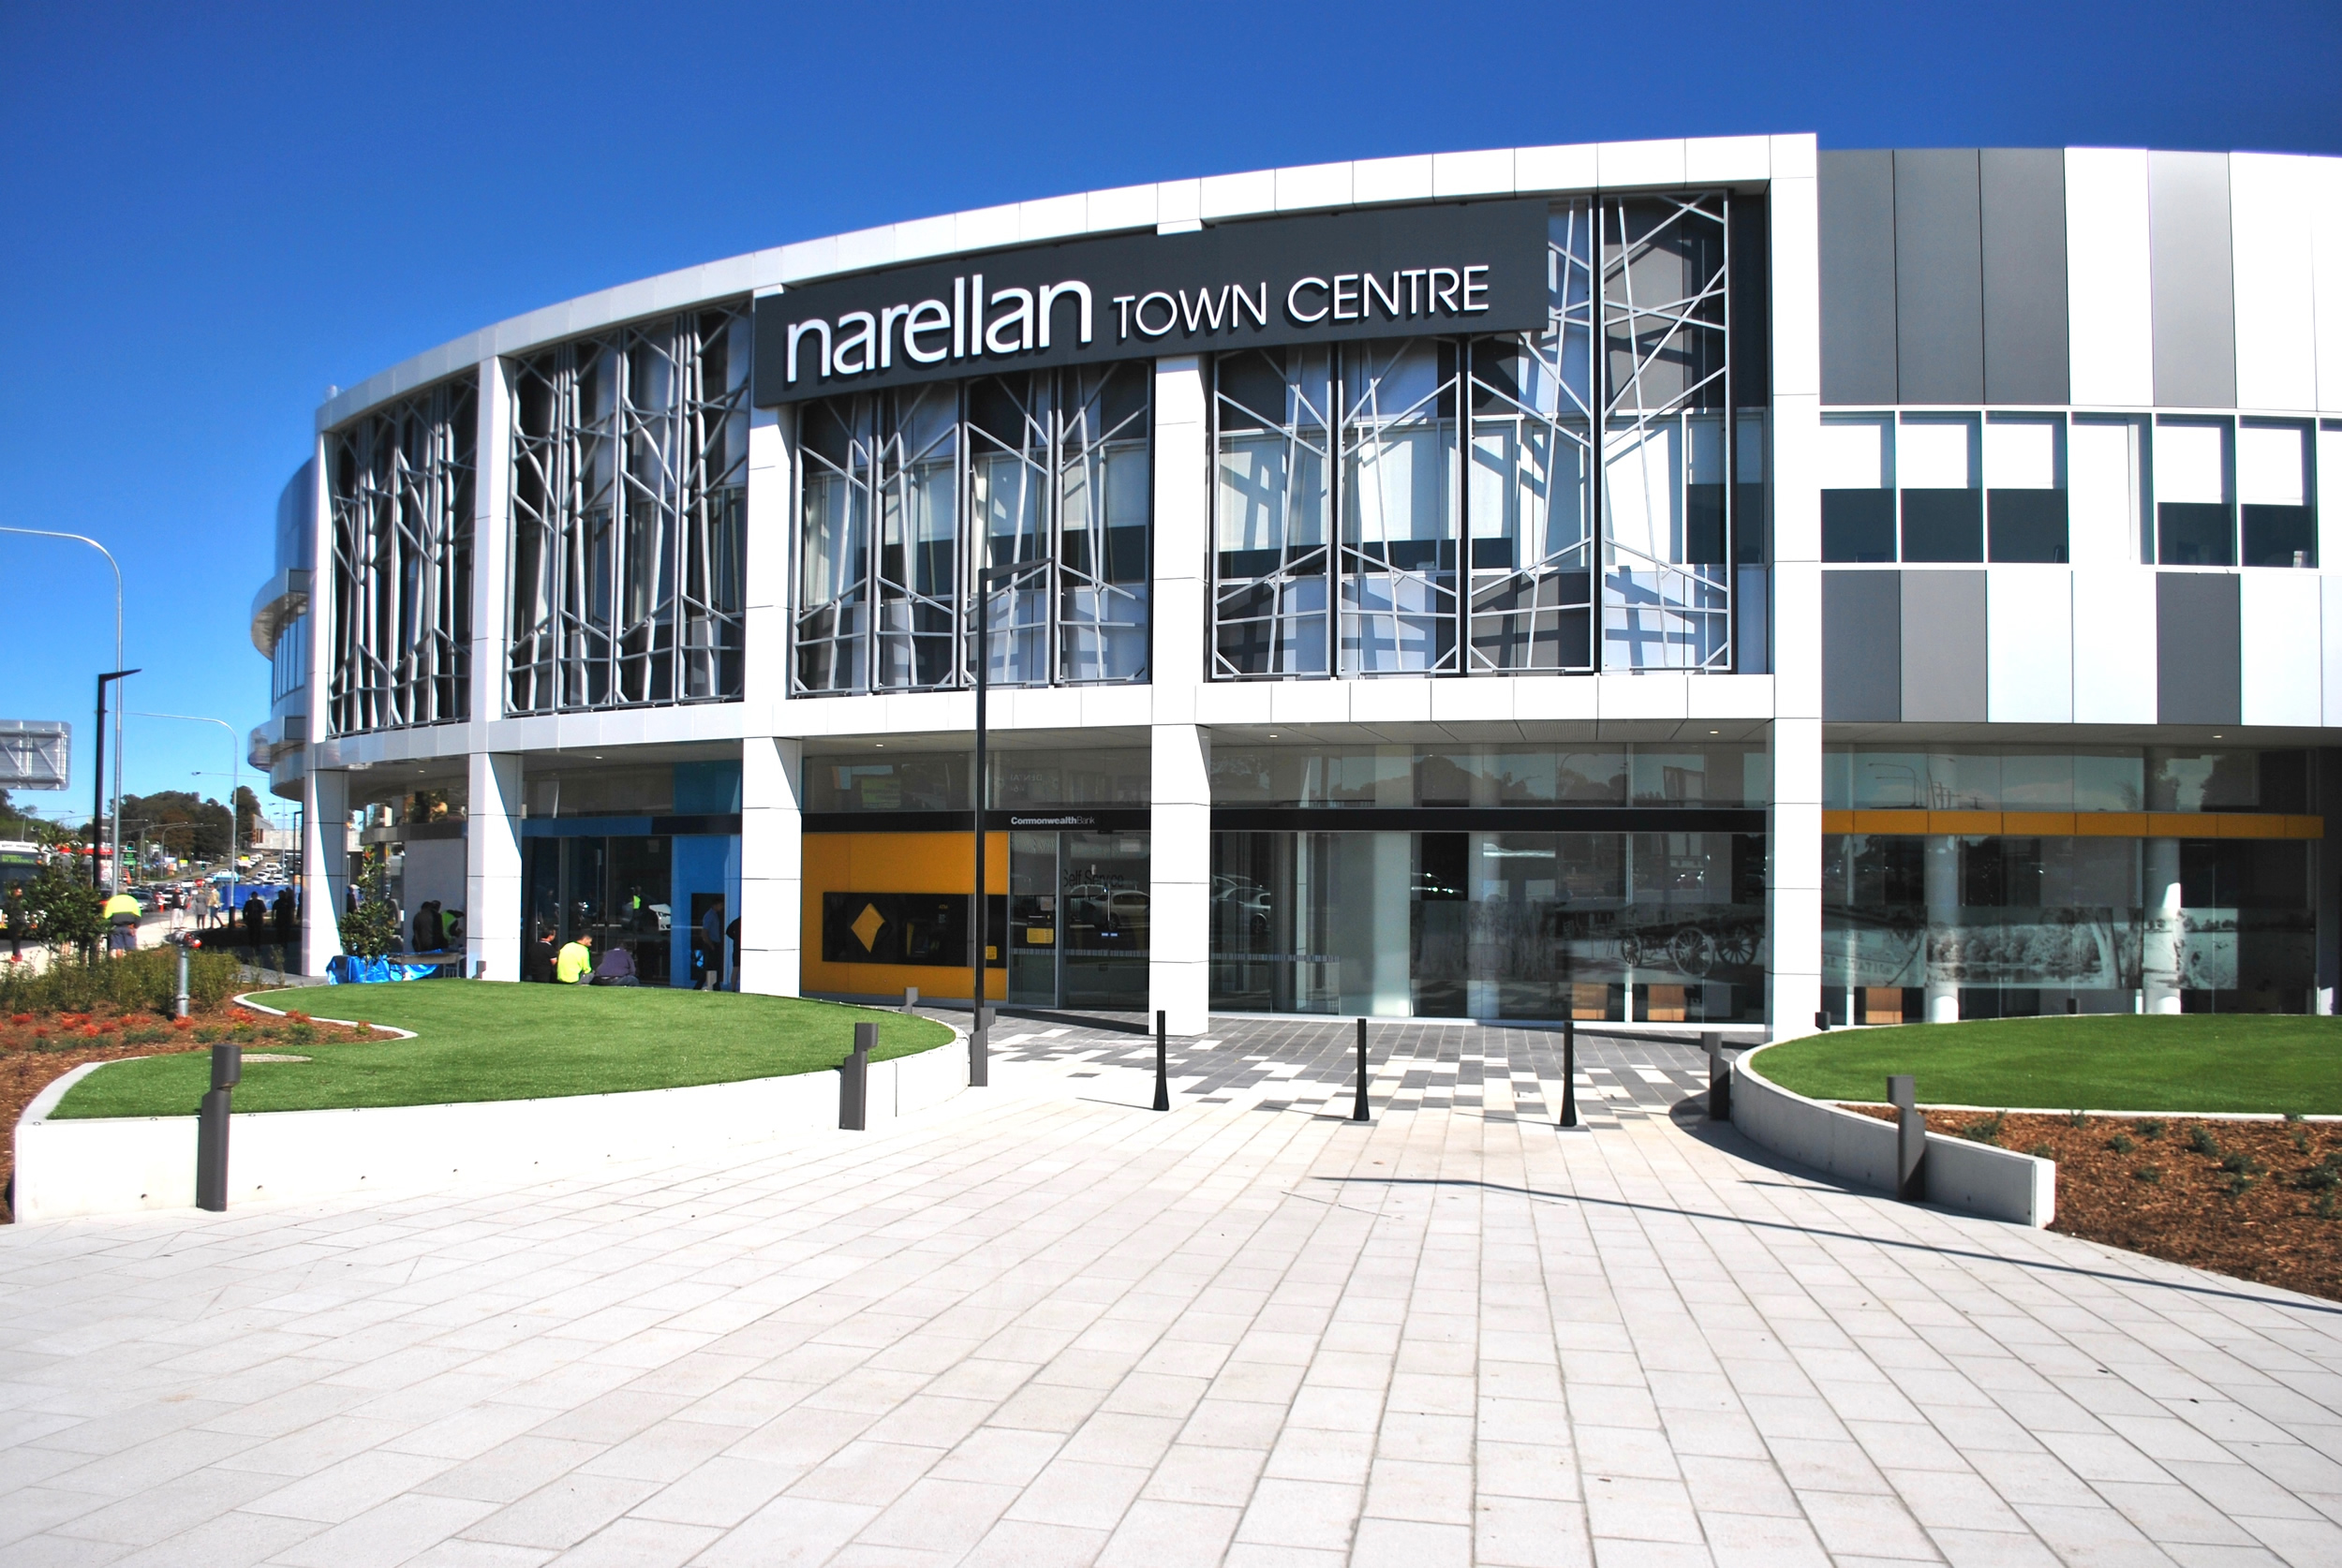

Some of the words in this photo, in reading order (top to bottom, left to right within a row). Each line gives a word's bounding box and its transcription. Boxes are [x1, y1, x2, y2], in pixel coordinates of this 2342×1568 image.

[787, 274, 1092, 383] narellan
[1112, 281, 1267, 339] TOWN
[1286, 264, 1490, 323] CENTRE
